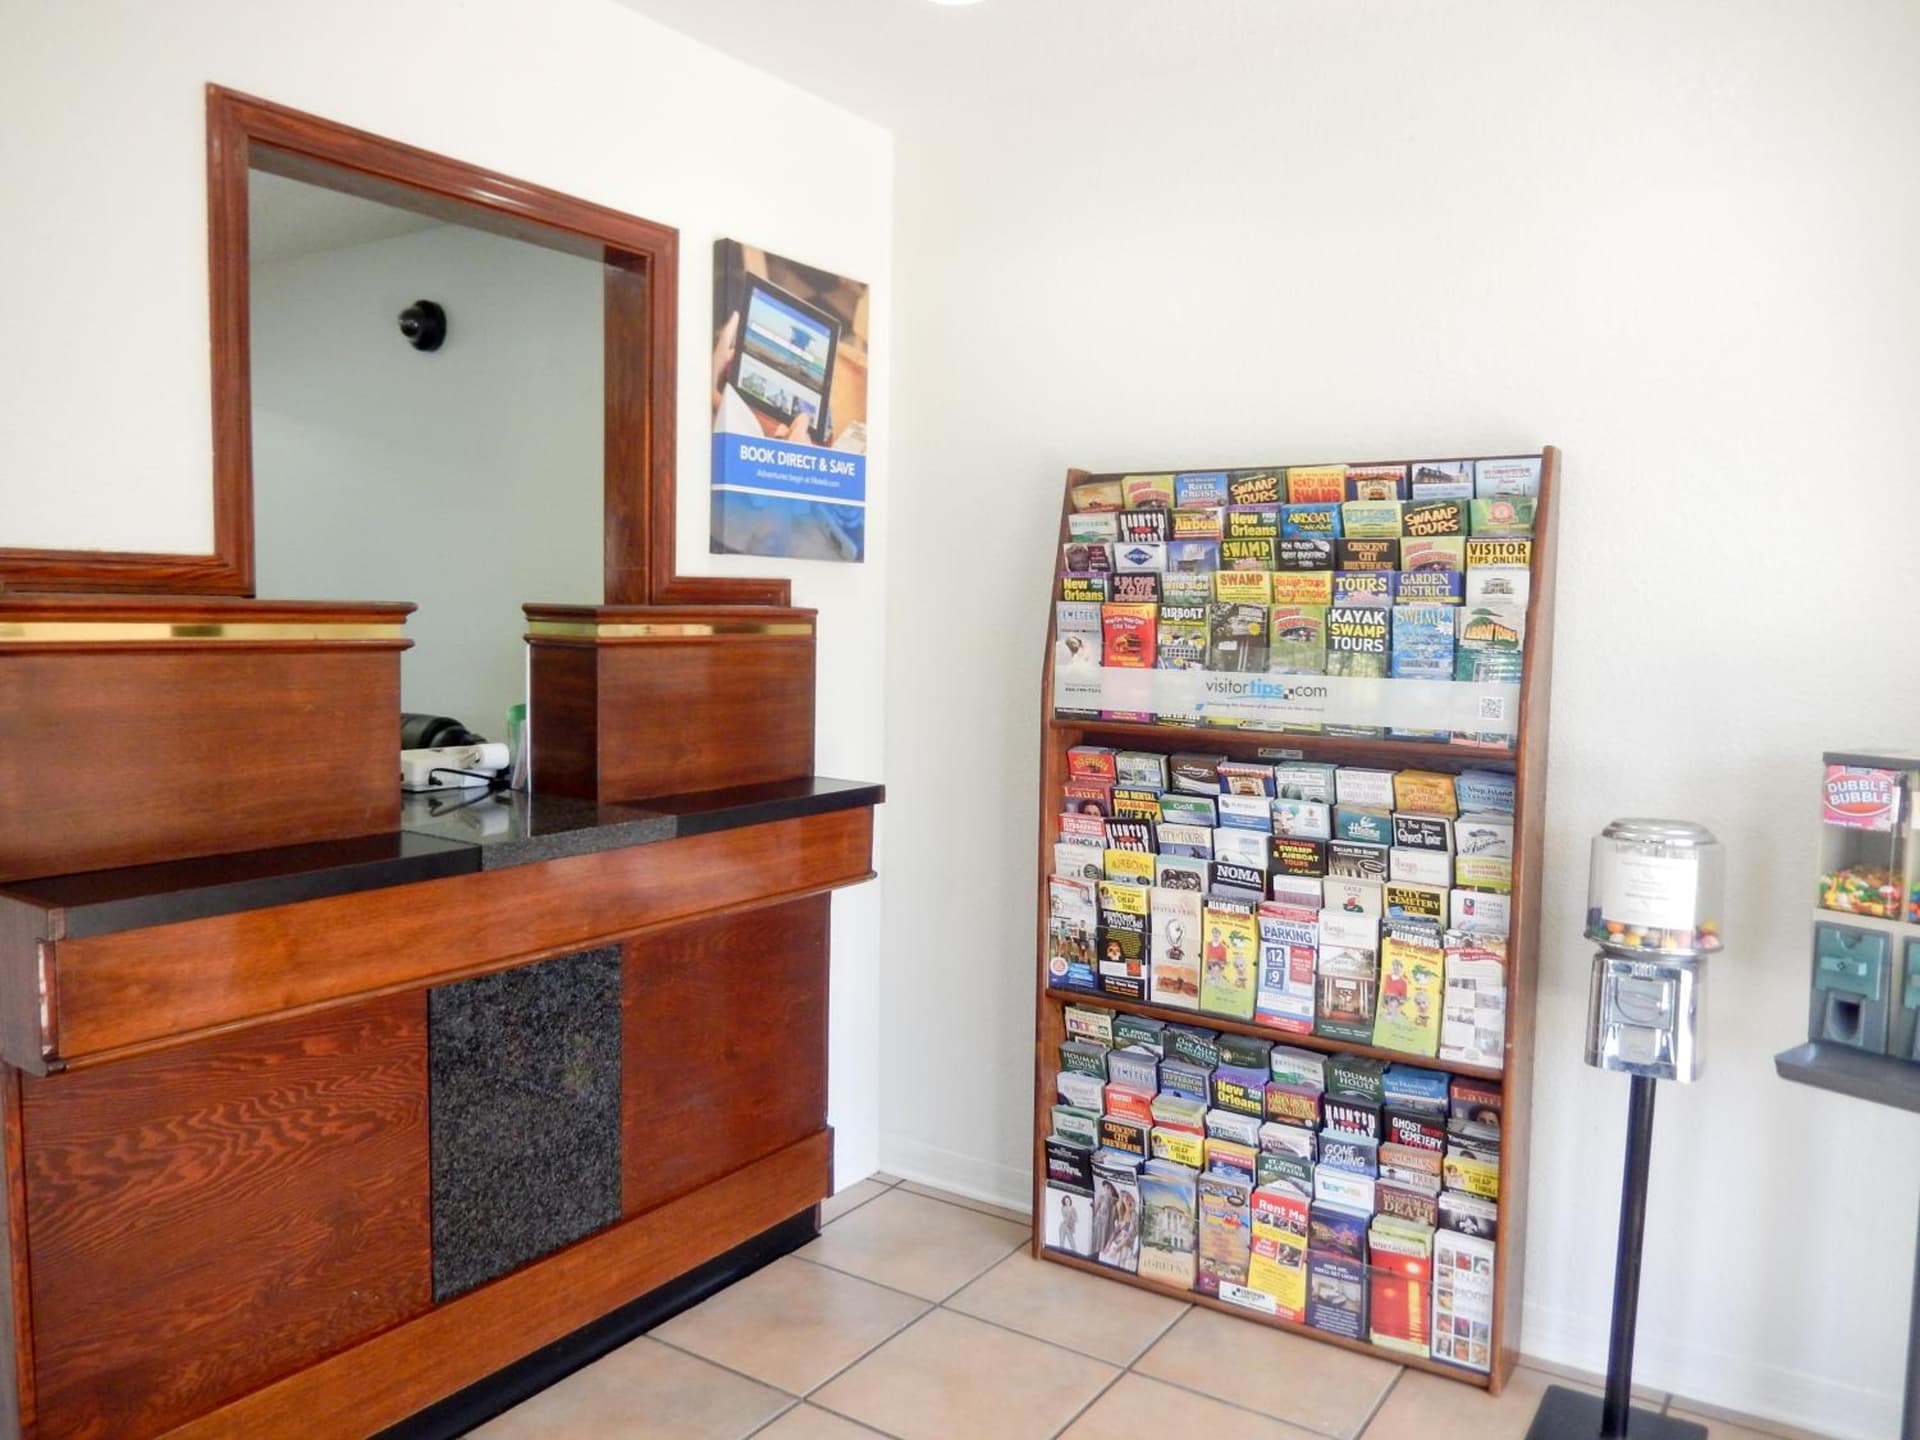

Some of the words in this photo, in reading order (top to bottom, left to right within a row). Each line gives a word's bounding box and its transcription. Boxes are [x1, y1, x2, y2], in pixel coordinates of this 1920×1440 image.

[740, 445, 776, 464] BOOK
[777, 451, 817, 470] DIRECT
[818, 458, 828, 472] &
[830, 460, 856, 476] SAVE
[1230, 477, 1277, 496] SWAMP
[1234, 490, 1278, 504] TOURS
[1230, 512, 1258, 525] New
[1404, 506, 1458, 526] SWAMP
[1231, 525, 1277, 536] Orleans
[1408, 520, 1458, 536] TOURS
[1222, 542, 1270, 557] SWAMP
[1470, 544, 1526, 556] VISITOR
[1470, 556, 1489, 564] TIPS
[1492, 556, 1527, 564] ONLINE
[1064, 578, 1088, 590] New
[1220, 574, 1263, 586] SWAMP
[1336, 577, 1387, 592] TOURS
[1400, 572, 1449, 585] GARDEN
[1064, 590, 1104, 600] Orleans
[1399, 585, 1452, 597] DISTRICT
[1160, 606, 1204, 620] AIRBOAT
[1332, 609, 1385, 624] KAYAK
[1332, 624, 1386, 638] SWAMP
[1332, 637, 1384, 652] TOURS
[1064, 786, 1104, 799] Laura
[1828, 780, 1889, 794] DUBBLE
[1830, 790, 1892, 806] BUBBLE
[1118, 808, 1158, 820] NIFTY
[1111, 858, 1151, 874] AIRBOAT
[1216, 864, 1262, 883] NOMA
[1396, 889, 1420, 898] CITY
[1388, 896, 1440, 909] CEMETERY
[1404, 906, 1425, 914] TOUR
[1264, 926, 1312, 944] PARKING
[1334, 1068, 1380, 1086] HOUMAS
[1217, 1080, 1244, 1096] New
[1340, 1078, 1376, 1091] HOUSE
[1218, 1092, 1262, 1114] Orleans
[1392, 1117, 1421, 1132] GHOST
[1400, 1129, 1443, 1147] CEMETERY
[1324, 1144, 1358, 1154] GONE
[1259, 1198, 1287, 1216] Rent
[1288, 1208, 1307, 1222] Me
[1384, 1200, 1435, 1223] DEATH
